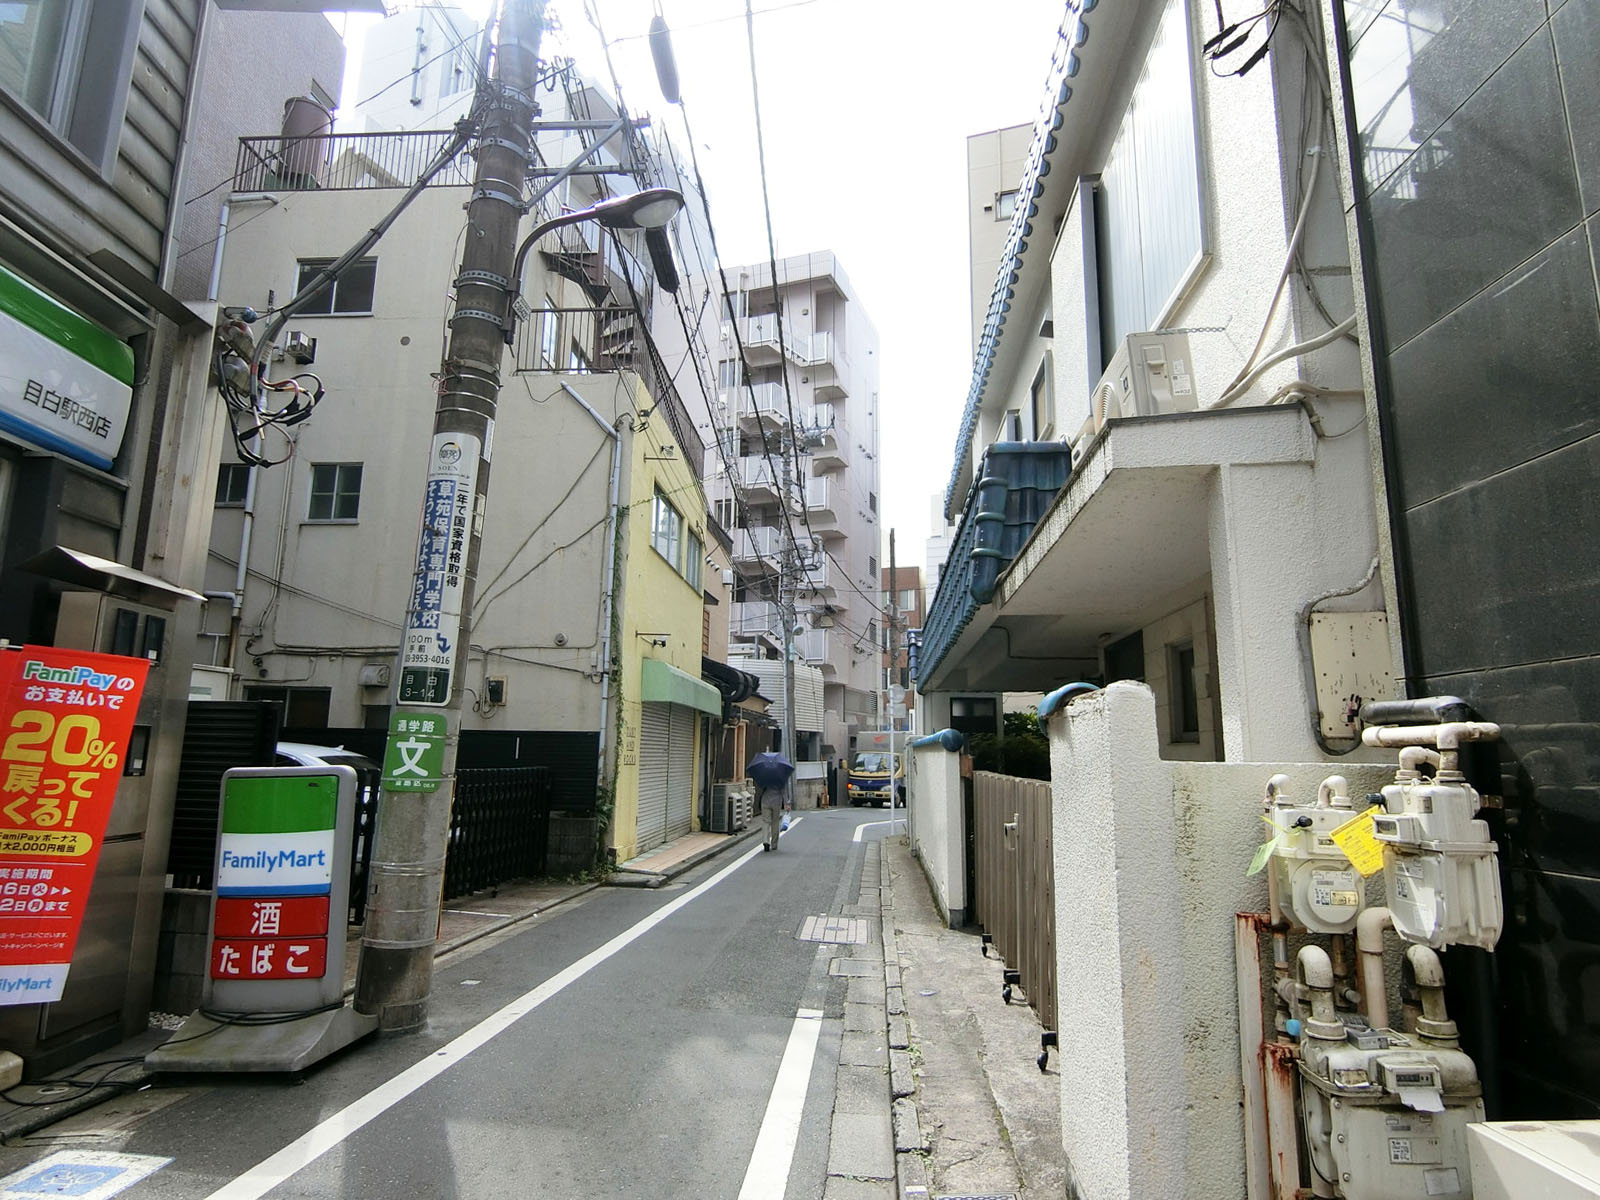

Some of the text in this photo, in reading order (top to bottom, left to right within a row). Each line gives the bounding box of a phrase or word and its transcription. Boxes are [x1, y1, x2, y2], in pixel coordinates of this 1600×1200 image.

[23, 379, 112, 439] 目白駅西店
[446, 482, 470, 588] 二年で国家資格取得
[421, 480, 454, 628] 草苑保育専門学校
[408, 634, 433, 644] 100m
[409, 645, 426, 653] 手前
[405, 687, 435, 698] 3-14
[406, 673, 438, 686] 目白
[24, 686, 125, 710] お支払いで
[1, 710, 119, 770] 20%
[397, 719, 435, 733] 通学路
[392, 736, 432, 777] 文
[2, 764, 101, 799] 戻って
[0, 842, 77, 853] 大2,000円相当
[222, 848, 325, 873] FamilyMart
[250, 901, 283, 936] 酒
[219, 943, 310, 975] たばこ
